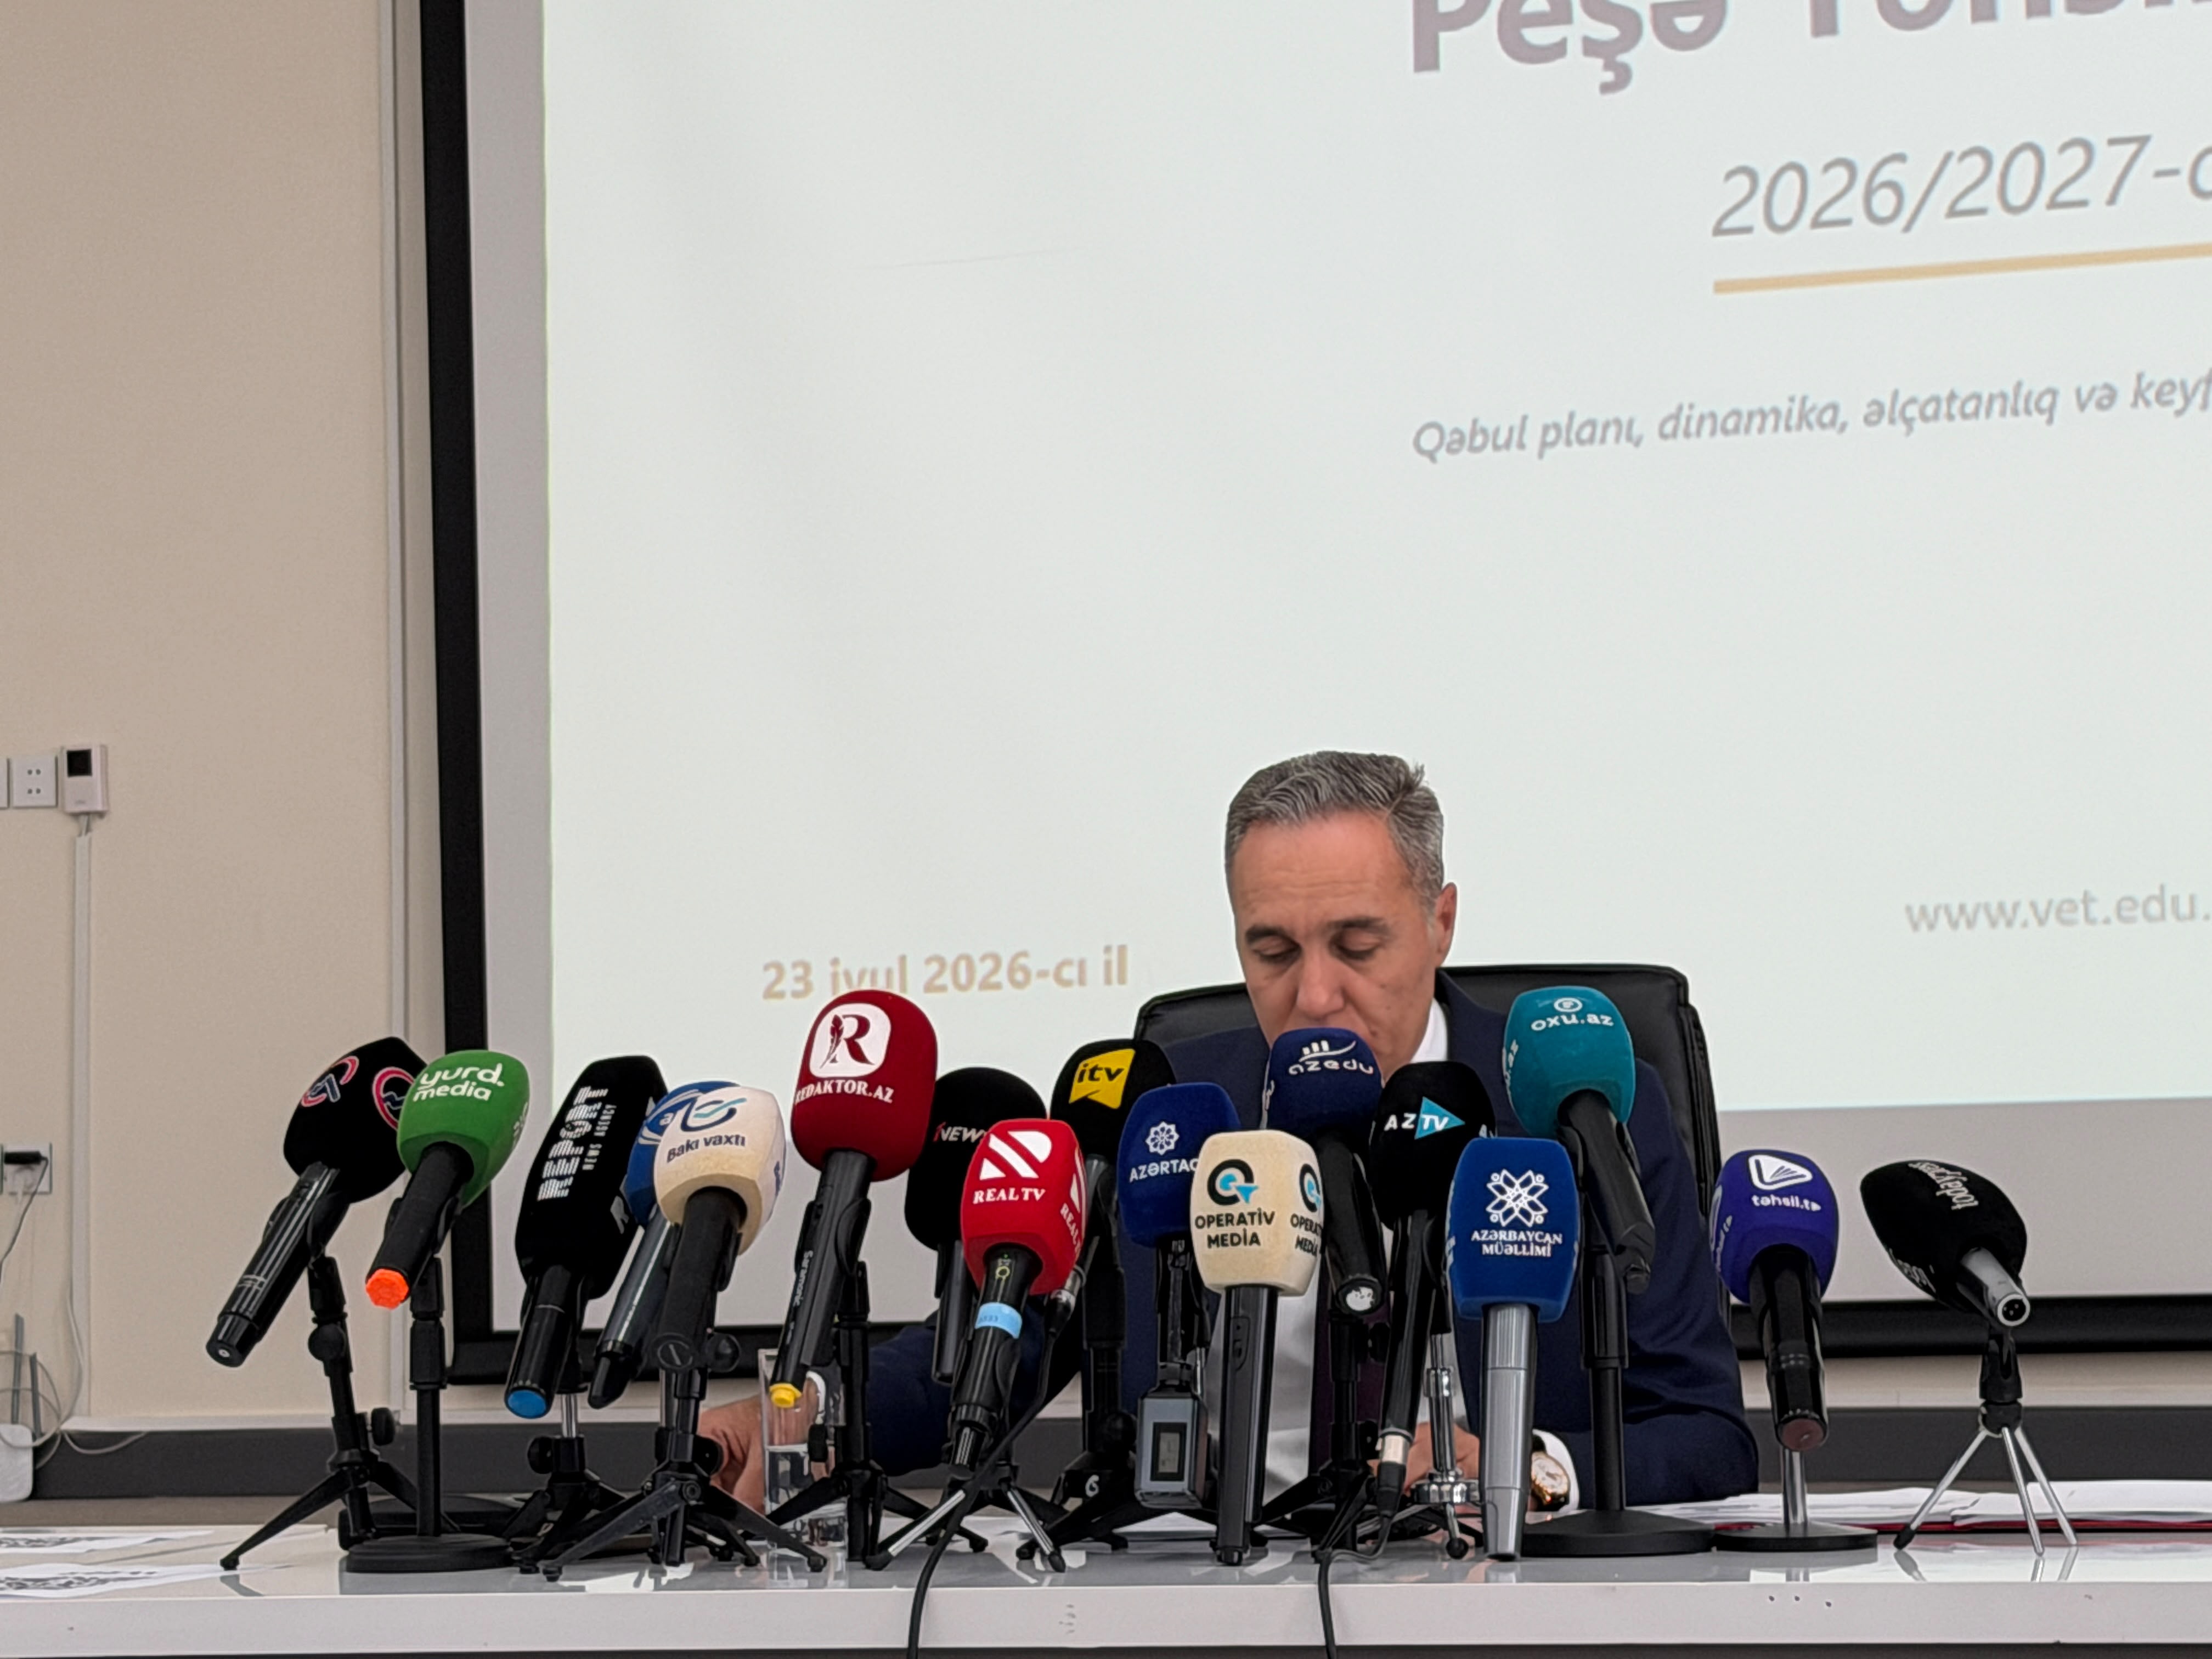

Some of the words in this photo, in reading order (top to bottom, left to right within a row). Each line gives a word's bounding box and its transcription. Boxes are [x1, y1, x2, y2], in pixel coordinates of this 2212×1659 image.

[1413, 415, 1528, 463] Qəbul
[1658, 394, 1848, 440] dinamika,
[1864, 381, 2059, 437] əlçatanlıq
[2075, 382, 2118, 412] və
[1905, 884, 2210, 932] www.vet.edu.
[762, 960, 814, 1000] 23
[1103, 945, 1128, 986] il
[1531, 1013, 1614, 1031] oxu.az
[1077, 1063, 1124, 1084] itv
[1289, 1059, 1374, 1075] azedu
[413, 1080, 492, 1102] media
[795, 1079, 894, 1105] REDAKTOR.AZ
[538, 1086, 609, 1201] REPORT
[667, 1139, 699, 1163] Bakı
[1195, 1207, 1276, 1229] OPERATİV
[1207, 1228, 1261, 1248] MEDİA
[1471, 1229, 1563, 1245] AZƏRBAYCAN
[1482, 1241, 1552, 1257] MÜƏLLİMİ
